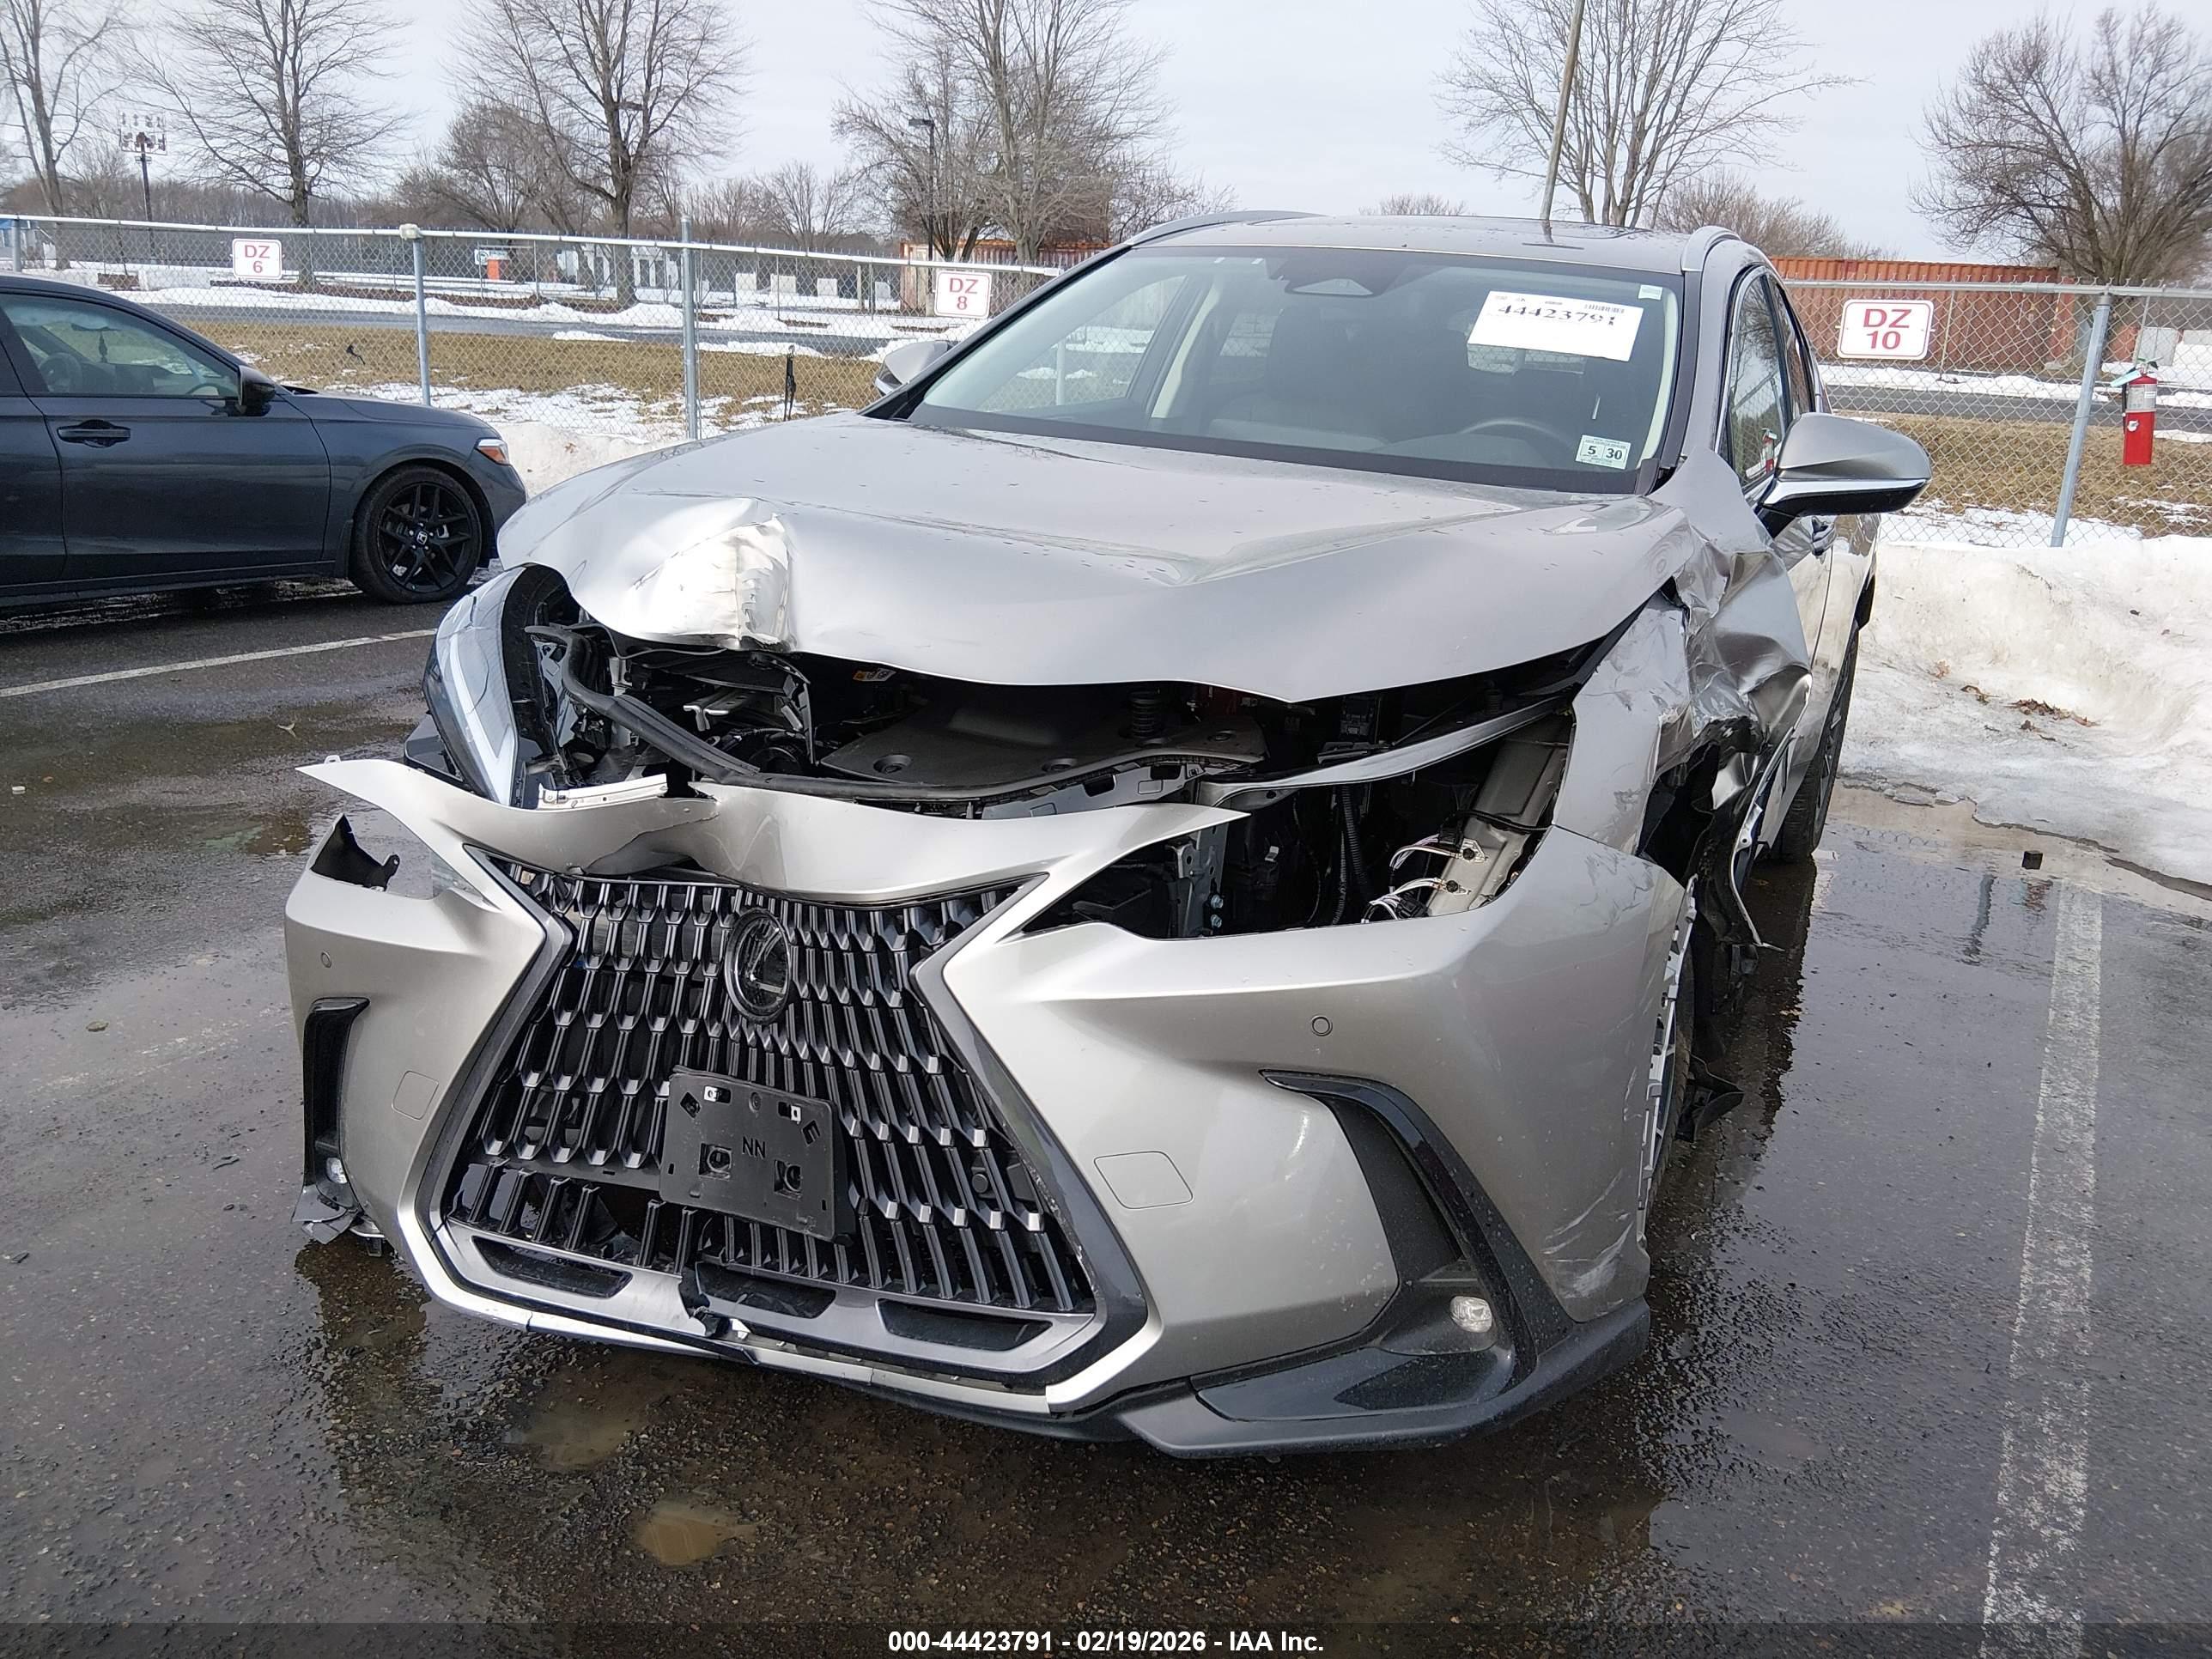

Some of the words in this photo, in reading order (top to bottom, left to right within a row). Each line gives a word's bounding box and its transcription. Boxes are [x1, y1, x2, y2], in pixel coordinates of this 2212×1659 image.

[245, 245, 270, 258] DZ
[253, 260, 263, 273] 6
[950, 277, 978, 295] DZ
[957, 295, 968, 310] 8
[1863, 308, 1911, 328] DZ
[1866, 331, 1901, 349] 10
[1587, 445, 1597, 455] 5
[1606, 447, 1623, 460] 30
